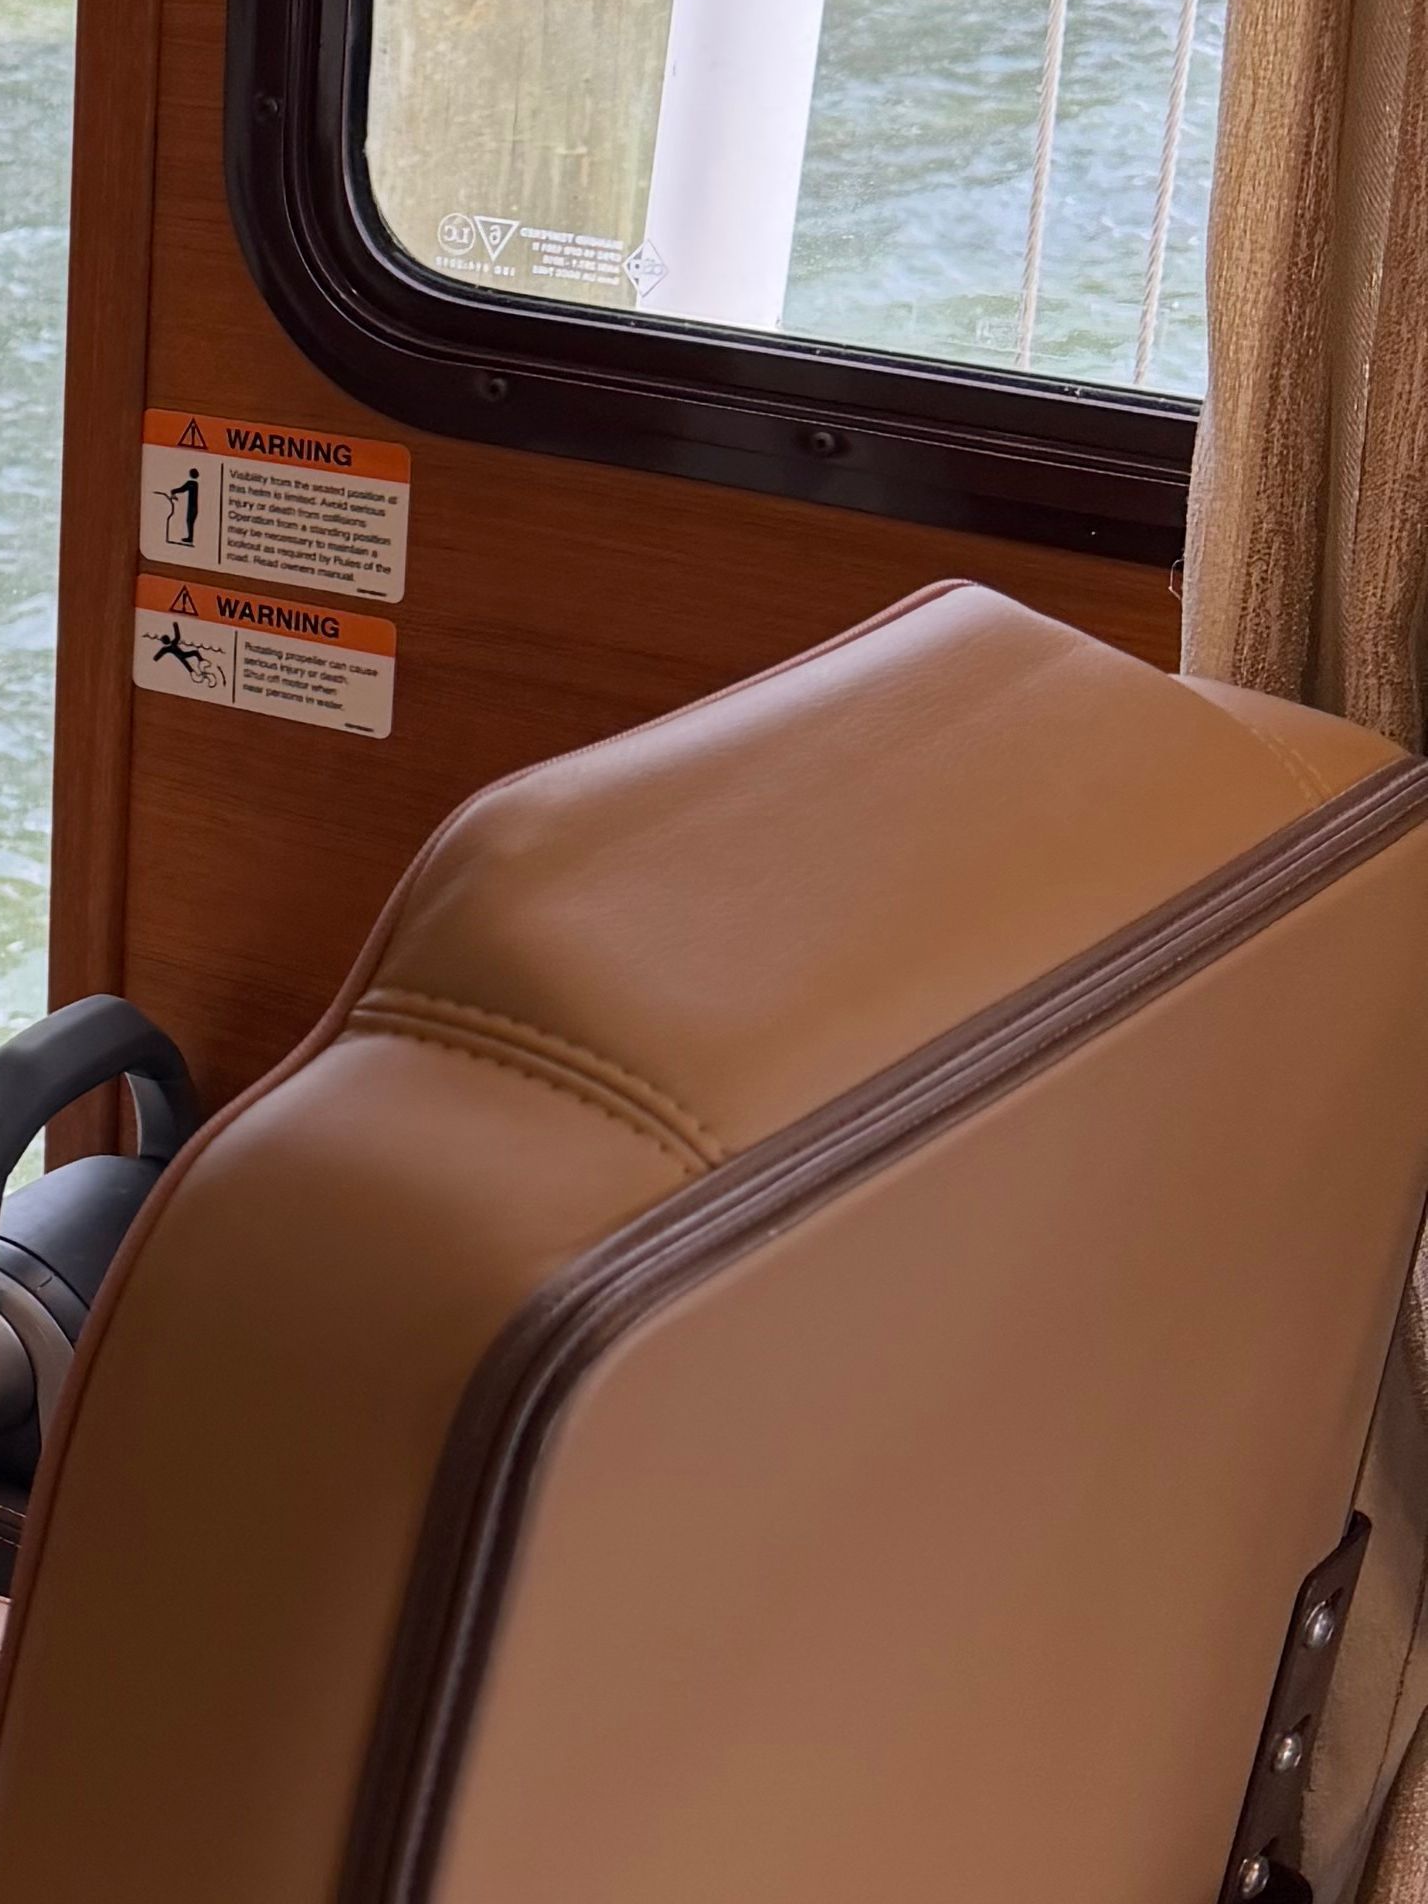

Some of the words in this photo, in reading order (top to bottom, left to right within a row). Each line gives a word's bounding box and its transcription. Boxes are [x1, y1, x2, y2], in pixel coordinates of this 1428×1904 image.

[226, 428, 353, 467] WARNING
[228, 468, 268, 485] Visibility
[269, 476, 291, 487] from
[293, 479, 310, 490] the
[346, 488, 385, 503] position
[228, 498, 254, 511] injury
[256, 503, 266, 511] or
[268, 503, 296, 516] death
[297, 508, 320, 519] from
[319, 498, 348, 511] Avoid
[349, 503, 386, 517] serious
[227, 525, 248, 536] may
[250, 528, 262, 537] be
[263, 532, 314, 548] necessary
[315, 539, 326, 548] to
[228, 510, 275, 526] Operation
[276, 518, 297, 529] from
[309, 524, 350, 540] standing
[352, 531, 391, 545] position
[227, 538, 261, 551] lookout
[263, 545, 275, 554] as
[277, 546, 317, 562] required
[318, 552, 331, 564] by
[332, 554, 362, 568] Rules
[363, 560, 374, 570] of
[374, 562, 392, 574] the
[253, 556, 278, 568] Read
[216, 595, 340, 640] WARNING
[243, 656, 278, 670] serious
[279, 663, 306, 677] injury
[284, 651, 327, 667] propeller
[328, 659, 346, 669] can
[348, 664, 378, 676] cause
[243, 668, 265, 680] Shut
[266, 673, 280, 683] off
[281, 677, 308, 689] motor
[311, 682, 337, 695] when
[265, 687, 303, 702] persons
